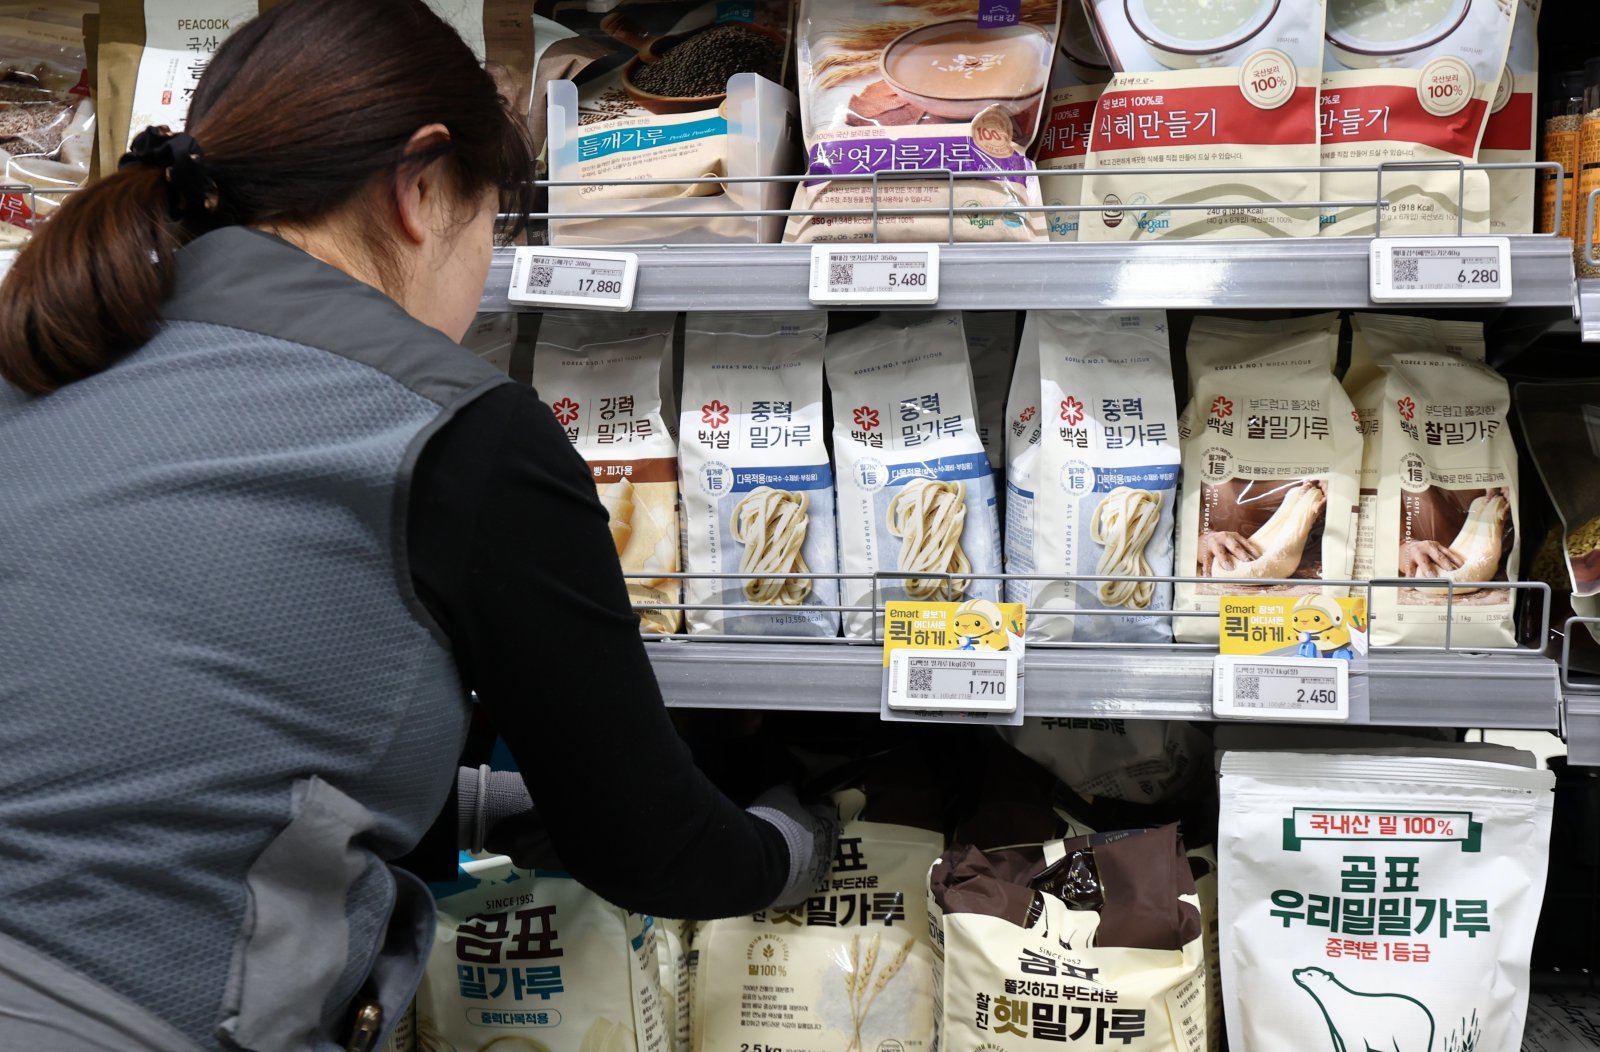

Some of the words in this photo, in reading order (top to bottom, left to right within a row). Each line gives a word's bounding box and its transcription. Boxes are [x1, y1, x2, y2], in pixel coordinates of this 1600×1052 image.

[178, 19, 230, 30] PEACOCK
[186, 35, 219, 53] 국산
[1253, 66, 1280, 77] 국산보리
[1431, 74, 1459, 83] 국산보리
[1251, 76, 1287, 94] 100%
[1427, 84, 1463, 98] 100%
[1131, 96, 1164, 107] 100%로
[1100, 108, 1216, 143] 식혜만들기
[1320, 106, 1390, 137] 만들기
[579, 129, 666, 157] 들깨가루
[848, 142, 975, 173] 엿기름가루
[578, 278, 621, 293] 17,880
[888, 273, 927, 287] 5,480
[1458, 269, 1498, 284] 6,280
[600, 395, 634, 420] 강력
[751, 401, 793, 422] 중력
[1102, 397, 1144, 422] 중력
[1250, 399, 1288, 411] 부드럽고
[1291, 399, 1320, 411] 쫄깃한
[566, 426, 579, 444] 설
[597, 419, 653, 444] 밀가루
[902, 415, 963, 447] 밀가루
[1104, 423, 1167, 449] 밀가루
[1207, 418, 1234, 436] 백설
[1248, 415, 1329, 440] 찰밀가루
[1400, 421, 1419, 440] 백설
[698, 430, 730, 449] 백설
[750, 425, 811, 449] 밀가루
[851, 430, 883, 448] 백설
[1060, 427, 1088, 448] 백설
[1208, 462, 1225, 475] 1등
[1277, 466, 1291, 475] 만든
[1408, 468, 1422, 482] 1등
[707, 477, 723, 490] 1등
[861, 471, 877, 485] 1등
[1069, 475, 1084, 489] 1등
[864, 520, 872, 561] PURPOSE
[890, 609, 919, 618] emart
[1225, 605, 1255, 614] emart
[889, 621, 912, 645] 퀵
[915, 630, 945, 645] 하게
[1225, 616, 1248, 641] 퀵
[1252, 627, 1284, 642] 하게
[969, 680, 1005, 694] 1,710
[1297, 689, 1336, 703] 2,450
[1310, 814, 1370, 835] 국내산
[1378, 816, 1397, 835] 밀
[1403, 817, 1454, 836] 100%
[832, 838, 867, 872] 표
[1341, 855, 1420, 893] 곰표
[832, 876, 879, 891] 부드러운
[485, 896, 515, 910] SINCE
[516, 893, 534, 906] 1952
[1270, 889, 1491, 938] 우리밀밀가루
[456, 905, 563, 964] 곰표
[1040, 947, 1061, 960] SINCE
[1325, 938, 1379, 960] 중력분
[1383, 942, 1431, 963] 1등급
[456, 964, 565, 1001] 밀가루
[1005, 979, 1059, 999] 쫄깃하고
[1063, 985, 1118, 1003] 부드러운
[481, 1011, 549, 1025] 중력다목적용
[993, 995, 1146, 1044] 햇밀가루
